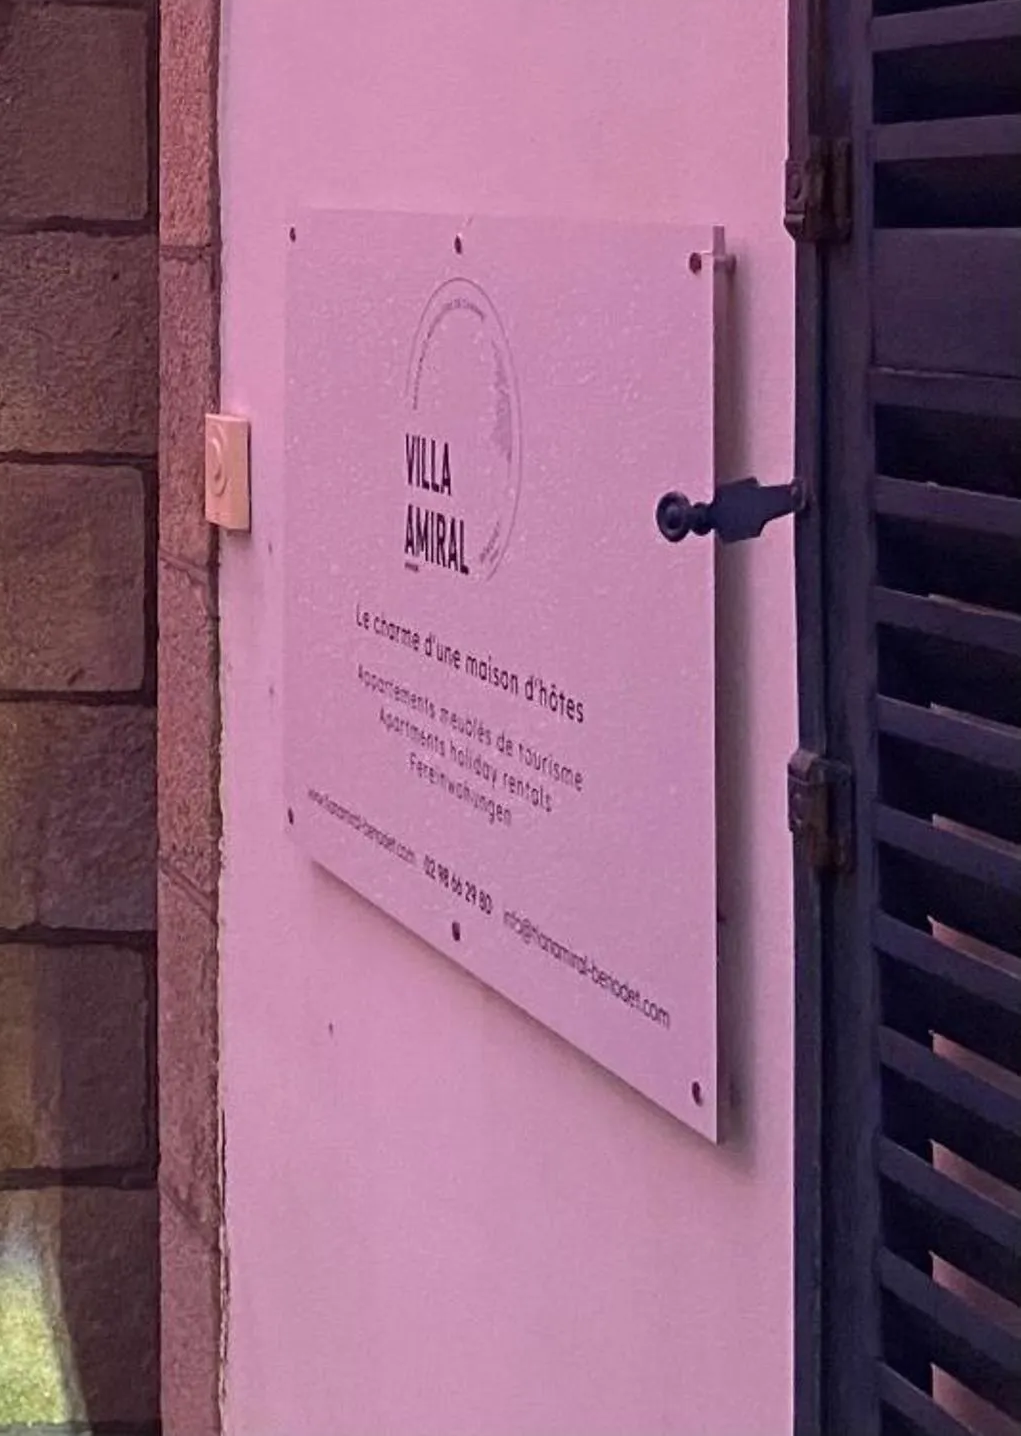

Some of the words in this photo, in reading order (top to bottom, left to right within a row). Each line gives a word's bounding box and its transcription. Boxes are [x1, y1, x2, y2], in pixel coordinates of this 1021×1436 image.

[405, 433, 451, 496] VILLA
[404, 504, 469, 575] AMIRAL
[356, 603, 370, 630] Le
[373, 611, 420, 651] charme
[424, 631, 460, 669] d'une
[465, 654, 519, 696] maison
[524, 675, 584, 723] d'hôtes
[449, 739, 497, 789] holiday
[503, 772, 552, 813] rentals
[496, 730, 513, 757] de
[517, 743, 584, 793] tourisme
